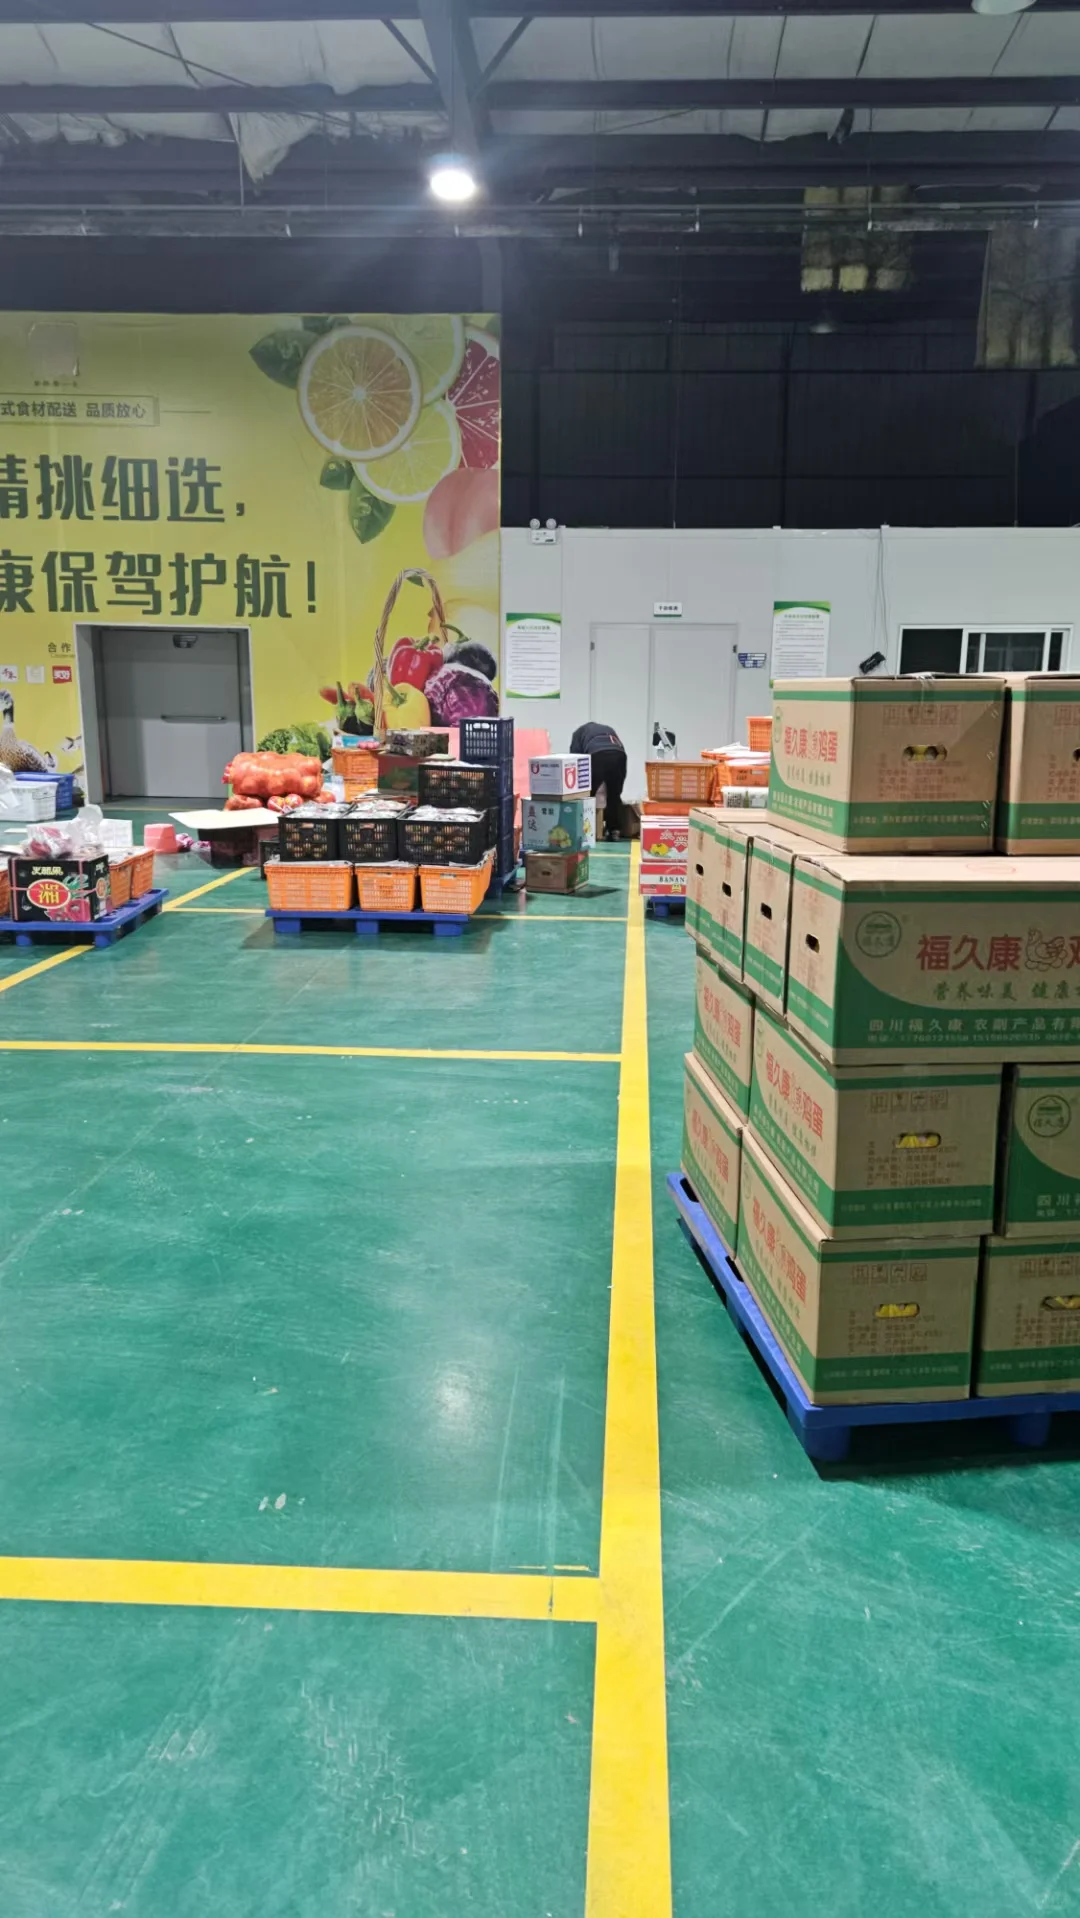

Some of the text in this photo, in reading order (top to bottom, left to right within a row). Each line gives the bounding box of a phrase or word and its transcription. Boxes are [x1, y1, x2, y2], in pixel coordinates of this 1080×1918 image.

[1, 400, 147, 419] 式食材配送 品质放心
[916, 934, 1022, 972] 福久康
[934, 980, 1017, 1001] 营养味美
